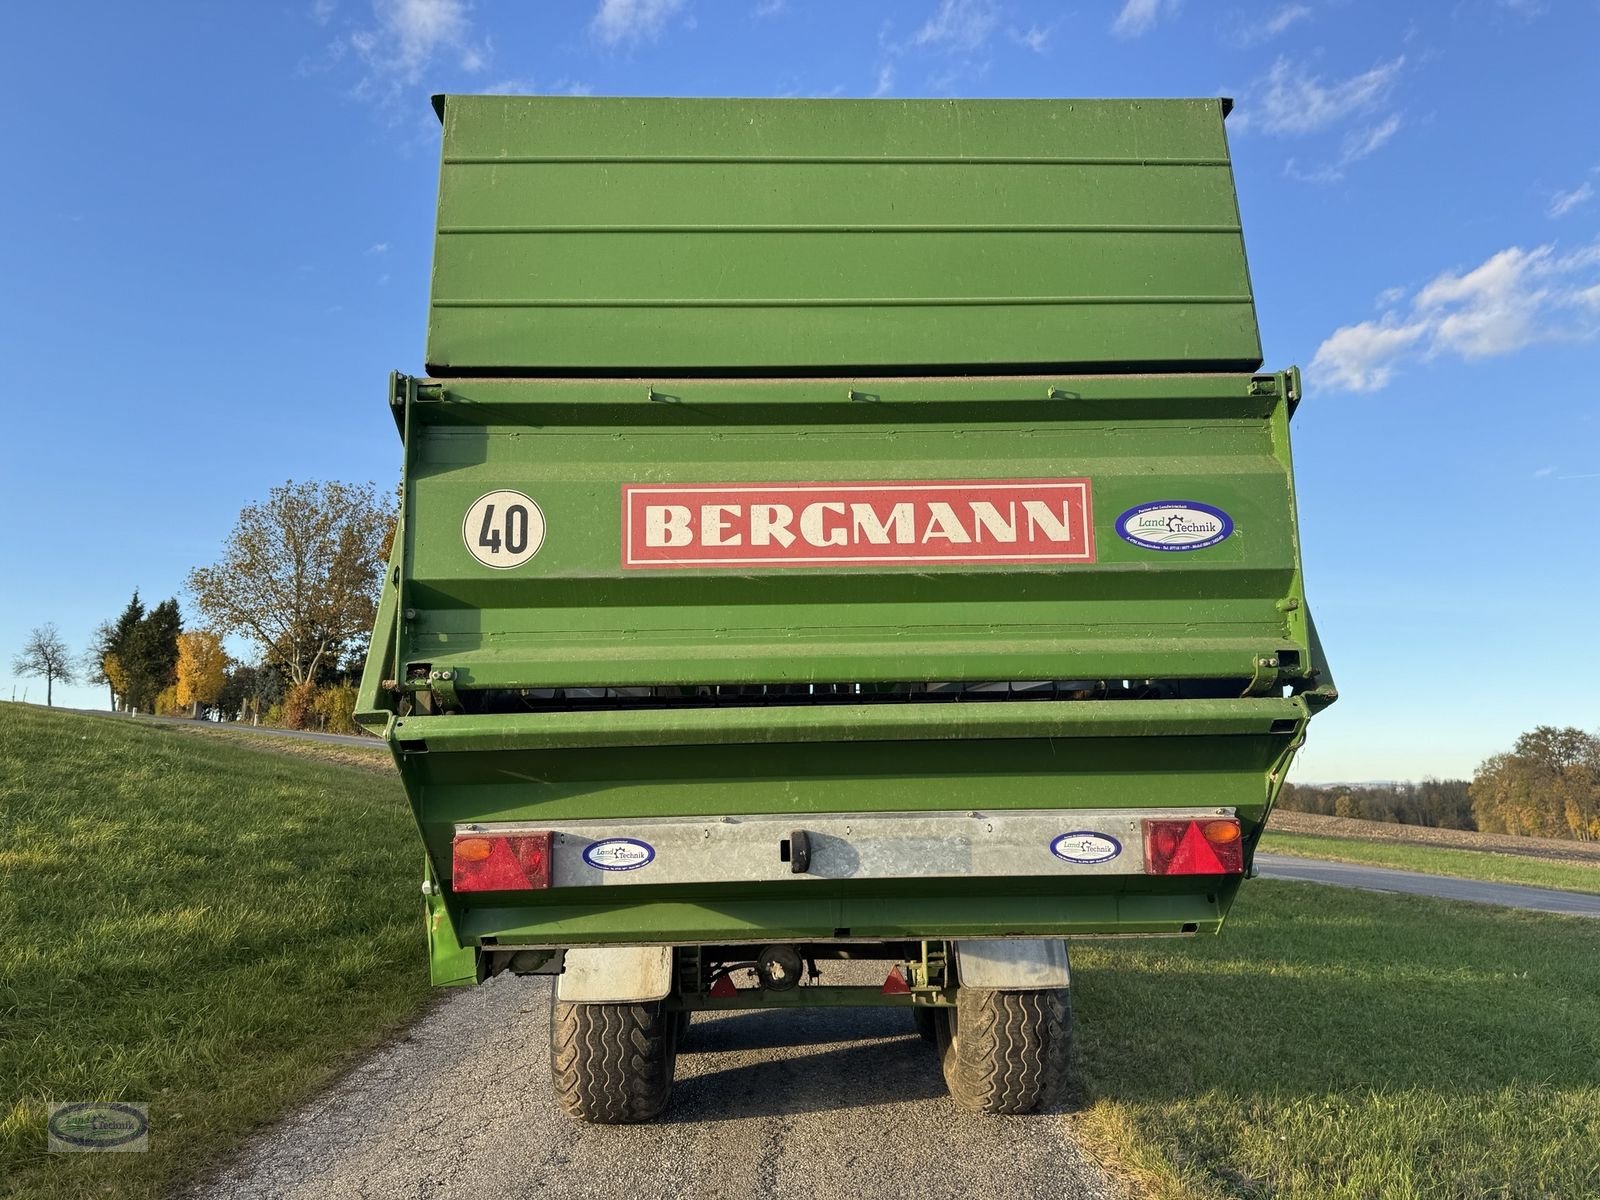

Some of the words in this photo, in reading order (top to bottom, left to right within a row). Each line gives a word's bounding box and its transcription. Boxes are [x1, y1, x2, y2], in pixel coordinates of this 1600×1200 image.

[645, 500, 1071, 549] BERGMANN
[1138, 516, 1165, 527] Land
[1174, 521, 1216, 532] Technik
[479, 504, 529, 554] 40
[1085, 845, 1112, 853] Technik
[619, 851, 645, 859] Technik
